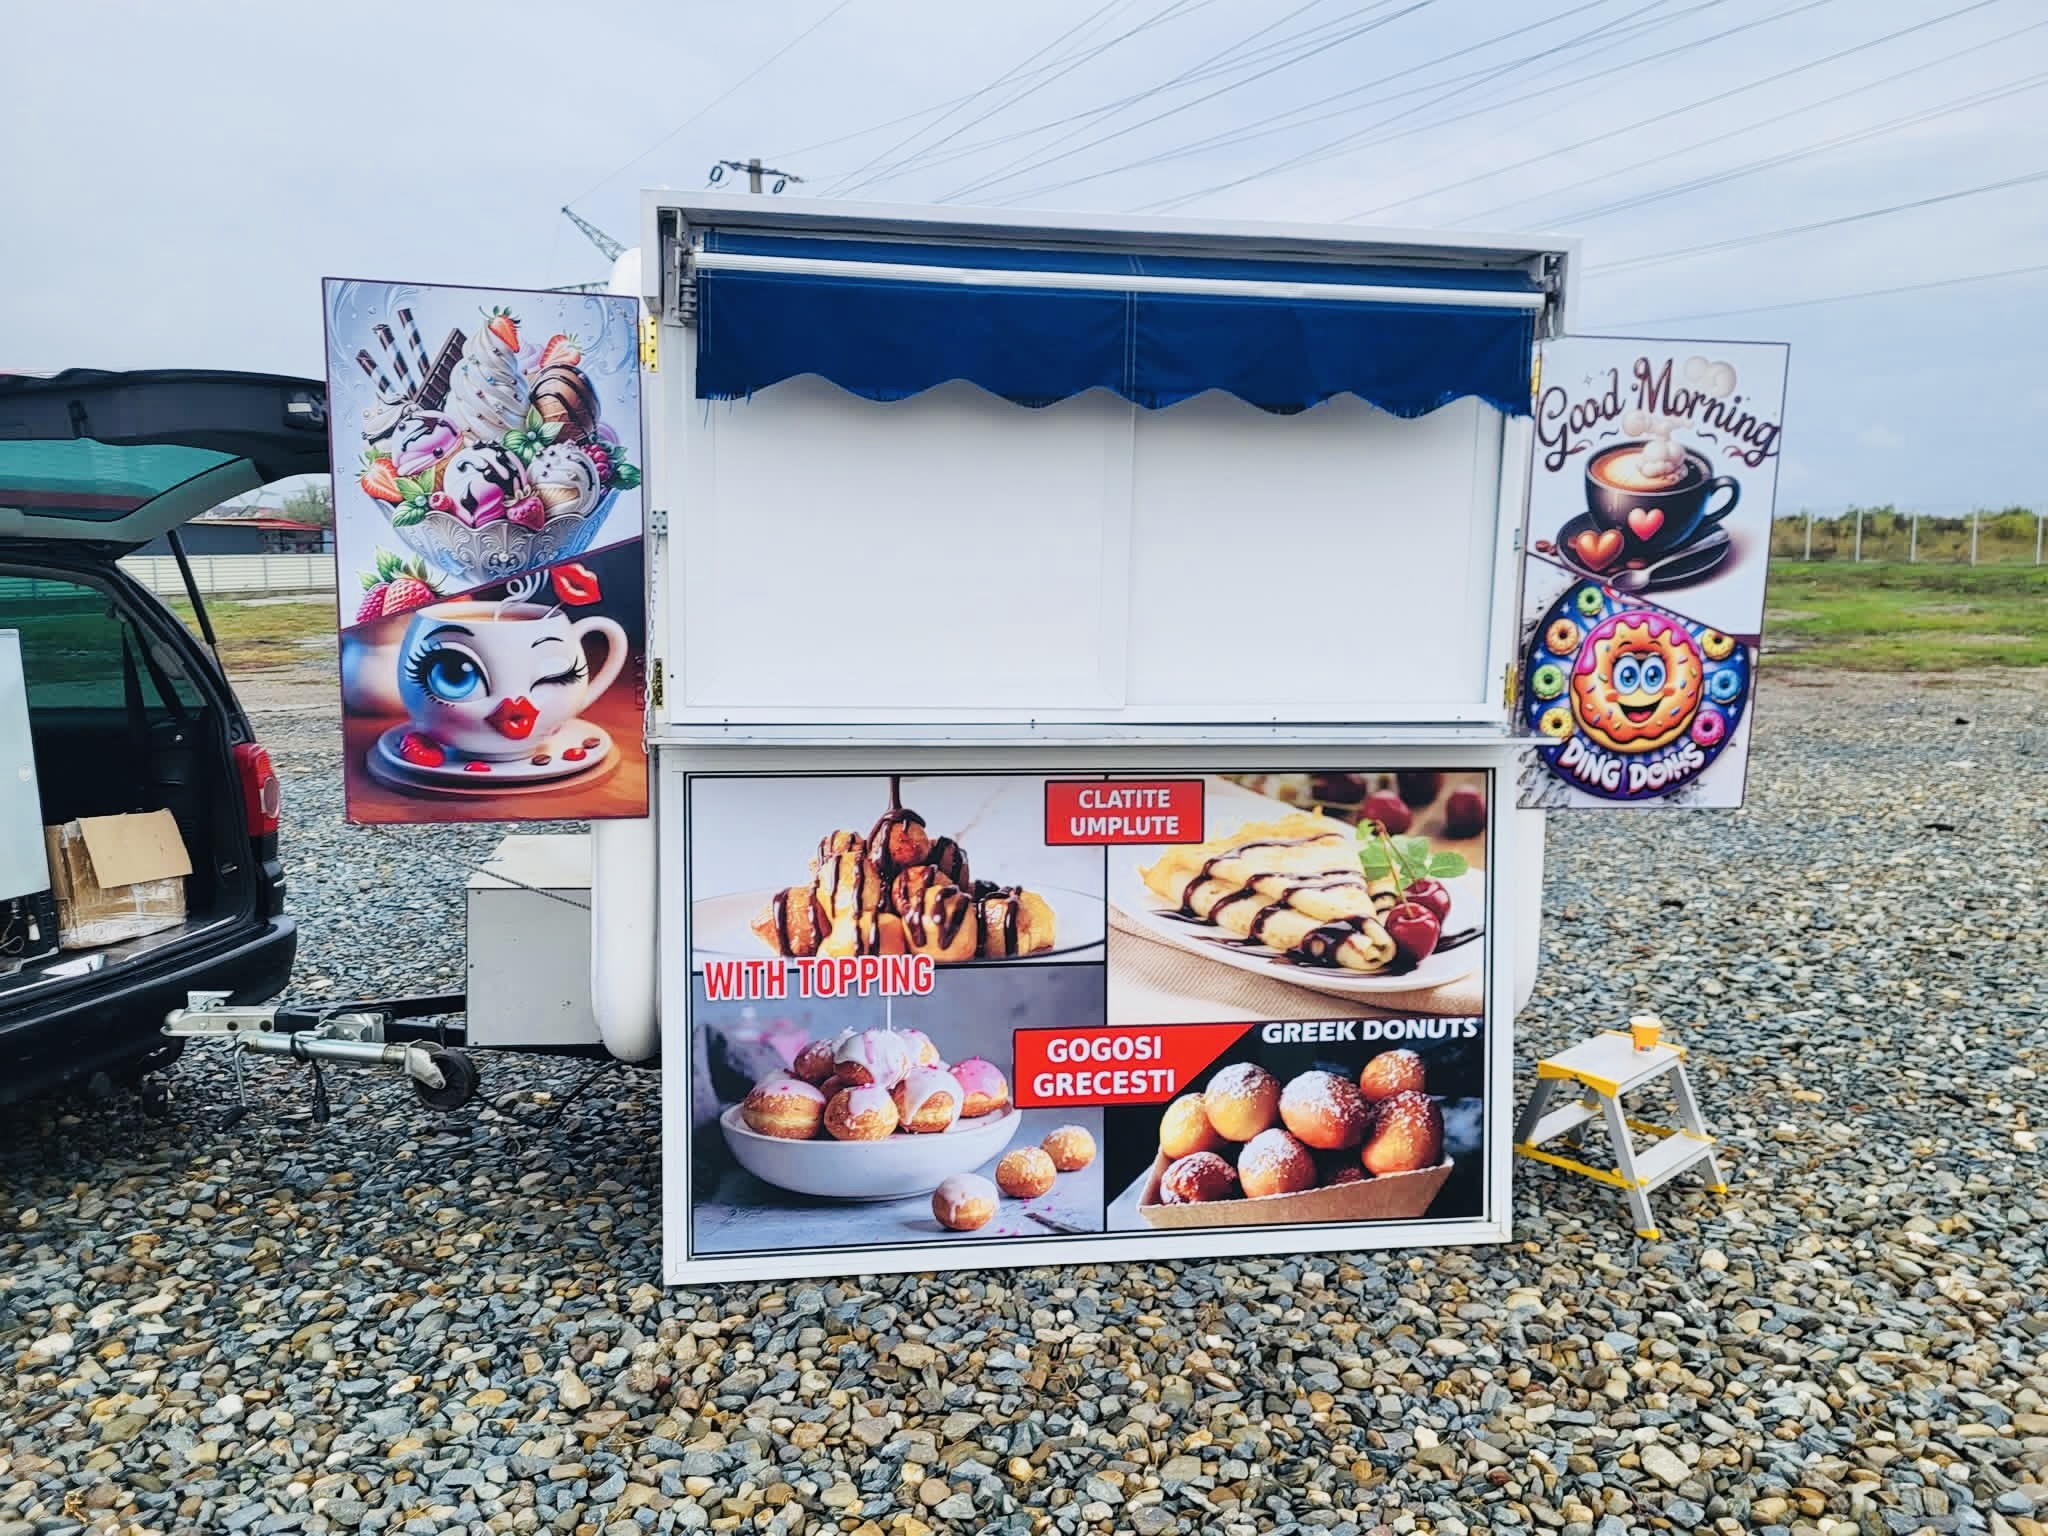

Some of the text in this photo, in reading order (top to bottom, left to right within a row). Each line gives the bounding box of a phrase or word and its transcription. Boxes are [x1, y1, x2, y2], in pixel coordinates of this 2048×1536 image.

[1538, 357, 1781, 472] Good Morning
[1557, 736, 1622, 792] DING
[1078, 789, 1171, 809] CLATITE
[1070, 815, 1180, 837] UMPLUTE
[704, 955, 934, 1000] WITH TOPPING
[1262, 1017, 1478, 1044] GREEK DONUTS
[1046, 1035, 1162, 1063] GOGOSI
[1033, 1069, 1175, 1098] GRECESTI
